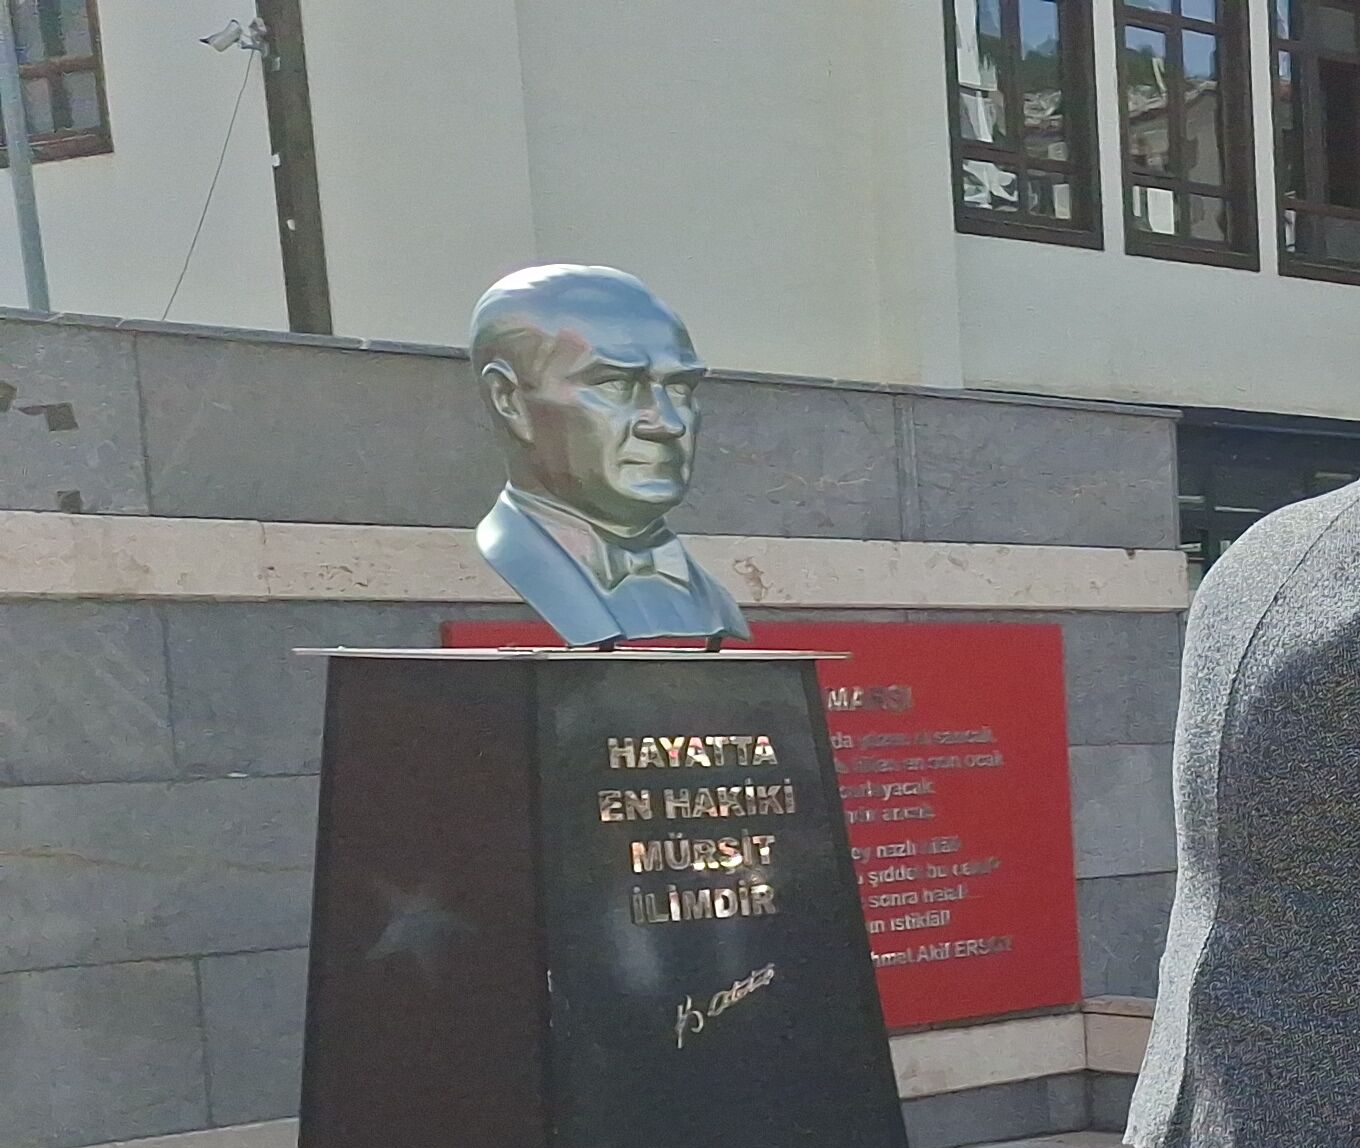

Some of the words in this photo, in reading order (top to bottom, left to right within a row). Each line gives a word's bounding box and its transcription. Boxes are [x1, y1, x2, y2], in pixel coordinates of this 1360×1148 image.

[607, 735, 778, 769] HAYATTA
[597, 788, 653, 822] EN
[663, 777, 796, 819] HAKİKİ
[629, 828, 777, 875] MÜRŞİT
[630, 878, 777, 924] İLİMDİR
